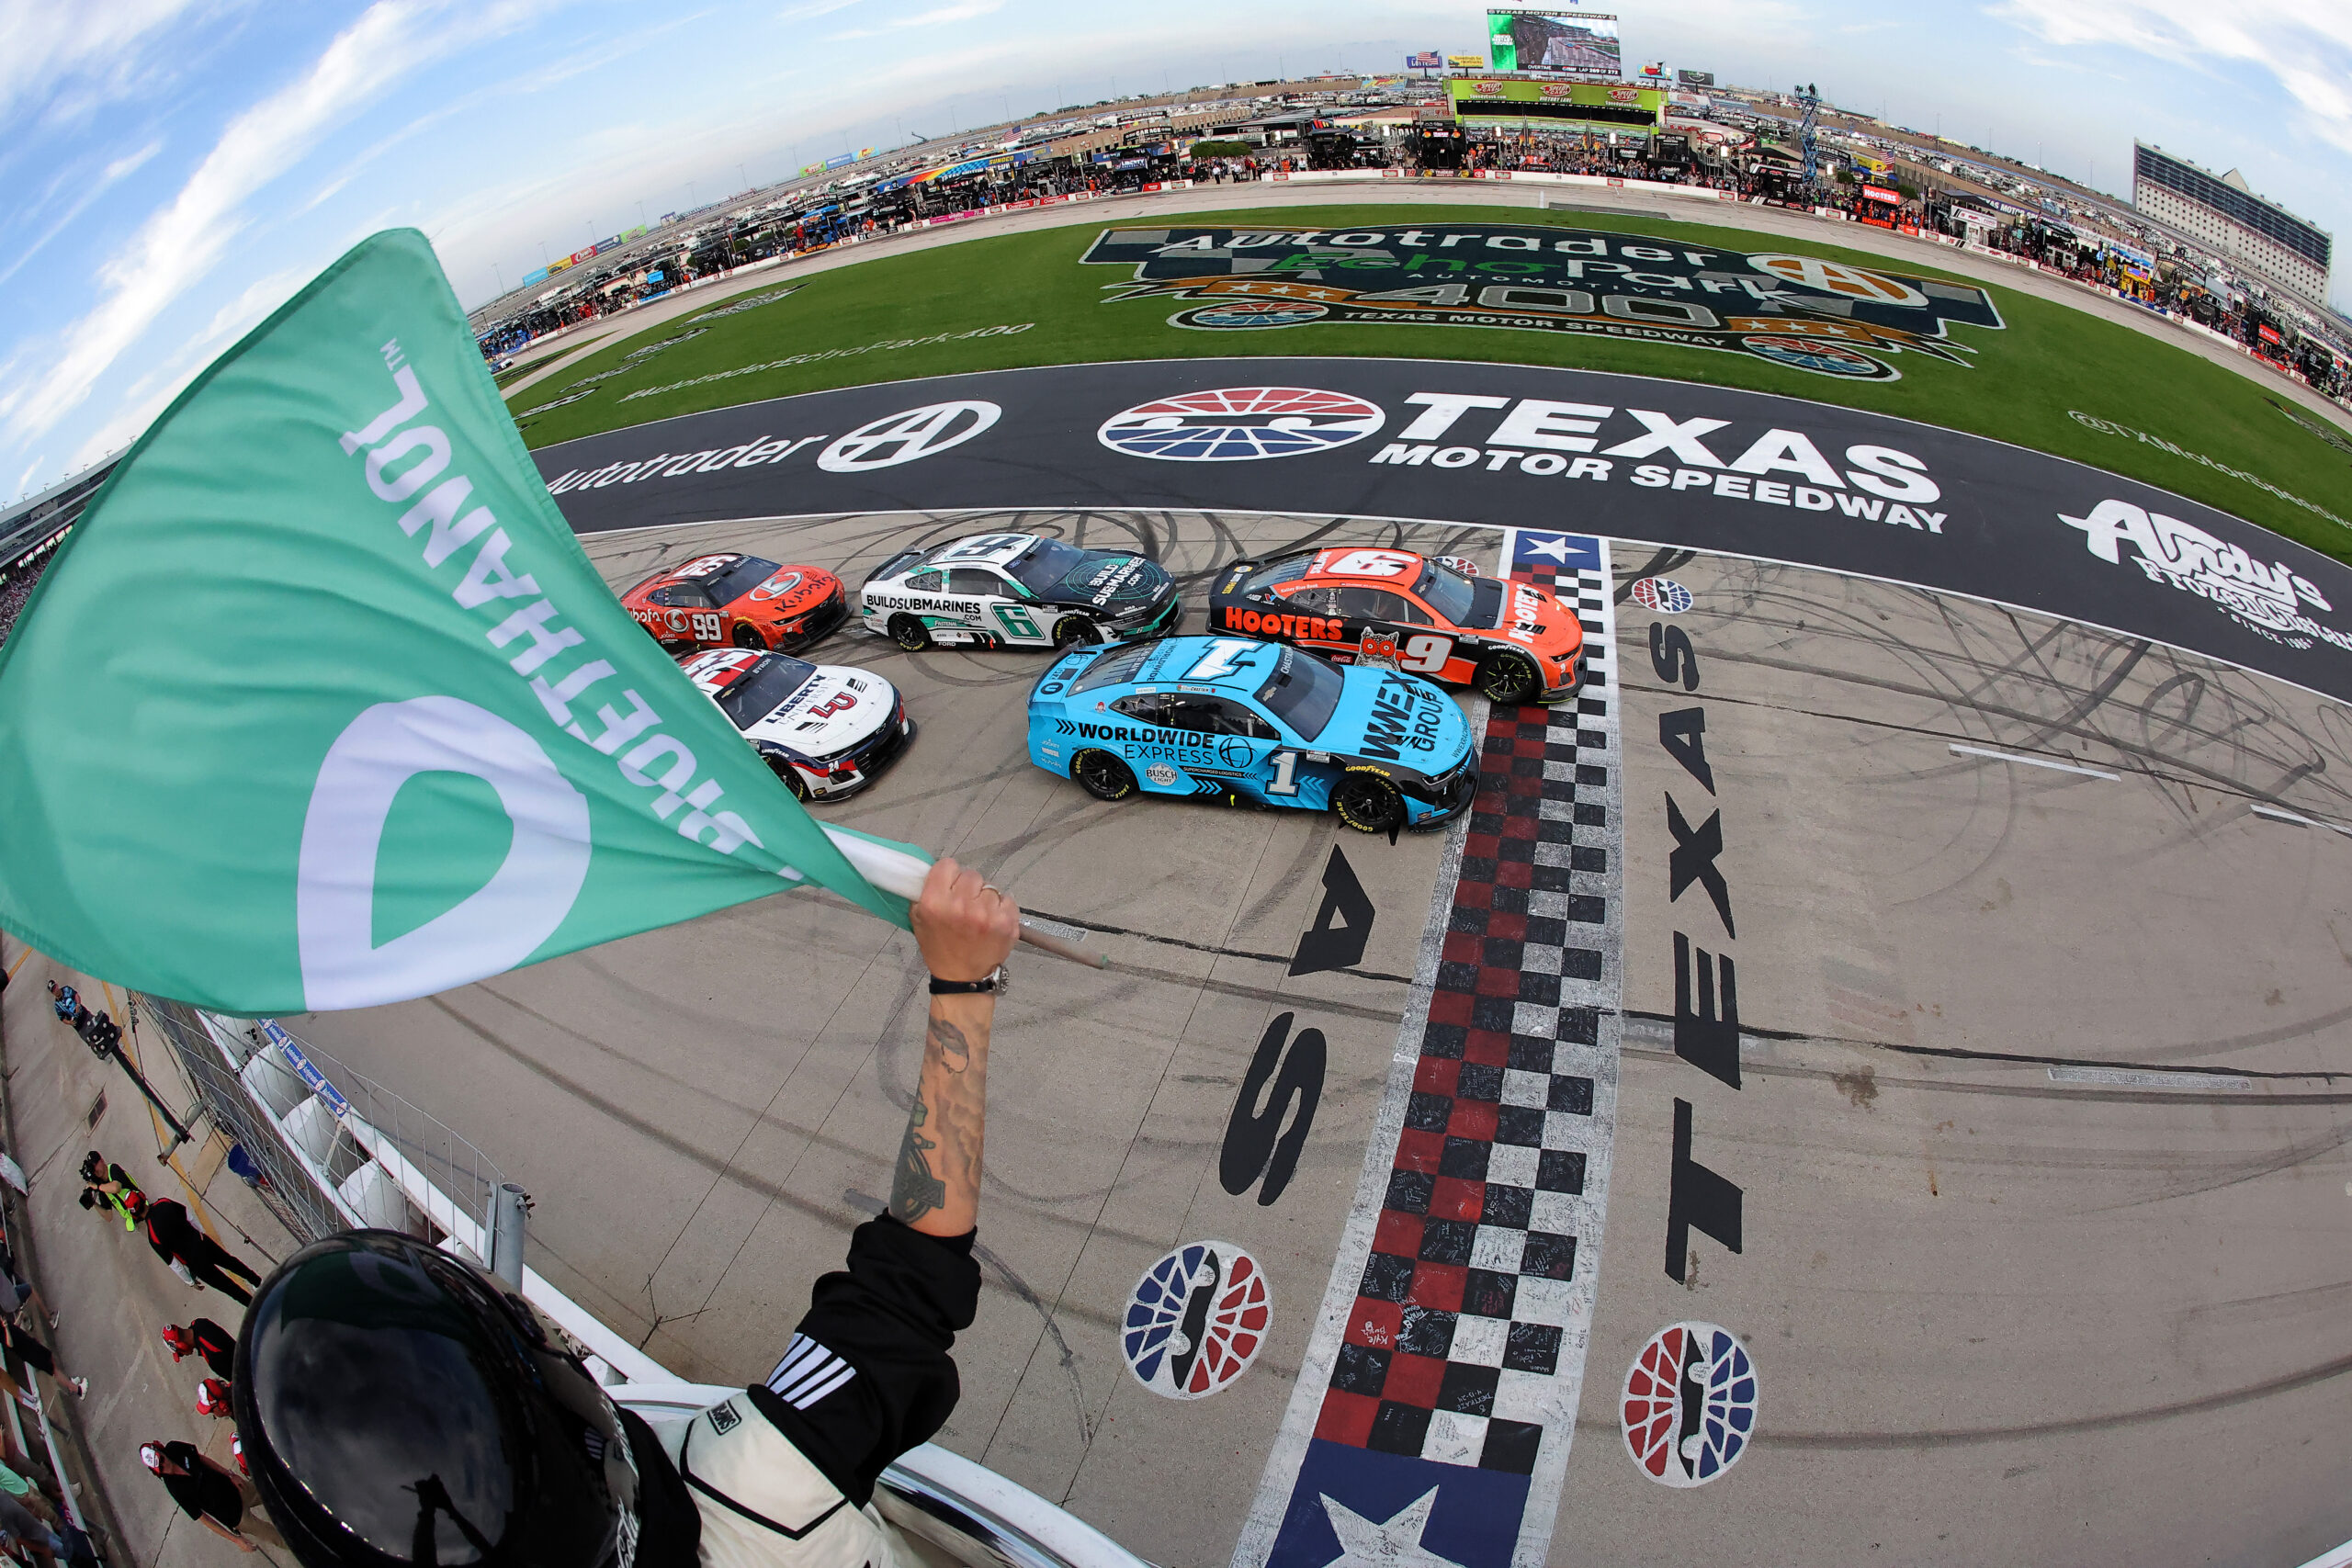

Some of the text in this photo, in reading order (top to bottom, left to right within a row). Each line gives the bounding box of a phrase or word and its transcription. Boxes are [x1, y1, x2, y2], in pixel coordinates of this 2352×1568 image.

[1136, 127, 1161, 137] GARAGE
[989, 155, 1014, 165] SUNOCO
[1864, 189, 1896, 202] HOOTERS
[1861, 217, 1893, 230] HOOTERS
[1148, 230, 1718, 266] Autotrader
[1407, 273, 1675, 296] AUTOMOTIVE
[1355, 283, 1720, 328] 400
[1344, 312, 1725, 346] TEXAS MOTOR SPEEDWAY
[1403, 392, 1941, 504] TEXAS
[1370, 443, 1948, 535] MOTOR SPEEDWAY
[2057, 499, 2334, 611] Andy's
[1091, 556, 1147, 606] SUBMARINES
[1094, 563, 1120, 588] BUILD
[775, 572, 837, 614] Kubota
[867, 595, 981, 615] BUILDSUBMARINES
[692, 614, 722, 641] 99
[990, 602, 1046, 640] 6
[1226, 606, 1343, 641] HOOTERS
[1401, 634, 1454, 673] 9
[1487, 645, 1525, 654] GOODYEAR
[752, 658, 773, 675] BYRON
[764, 674, 827, 725] LIBERTY
[807, 691, 859, 720] LU
[1359, 671, 1419, 761] WWEX
[1414, 692, 1443, 752] GROUP
[1079, 722, 1215, 750] WORLDWIDE
[761, 748, 790, 759] GOODYEAR
[829, 761, 840, 773] 24
[1125, 744, 1215, 765] EXPRESS
[1146, 768, 1178, 780] BUSCH
[1183, 766, 1243, 778] SUPERCHARGED LOGISTICS
[1264, 750, 1301, 797] 1
[1345, 764, 1391, 778] GOODYEAR
[1115, 784, 1130, 799] EAGLE
[1336, 801, 1374, 832] GOODYEAR
[1649, 622, 1743, 1285] TEXAS
